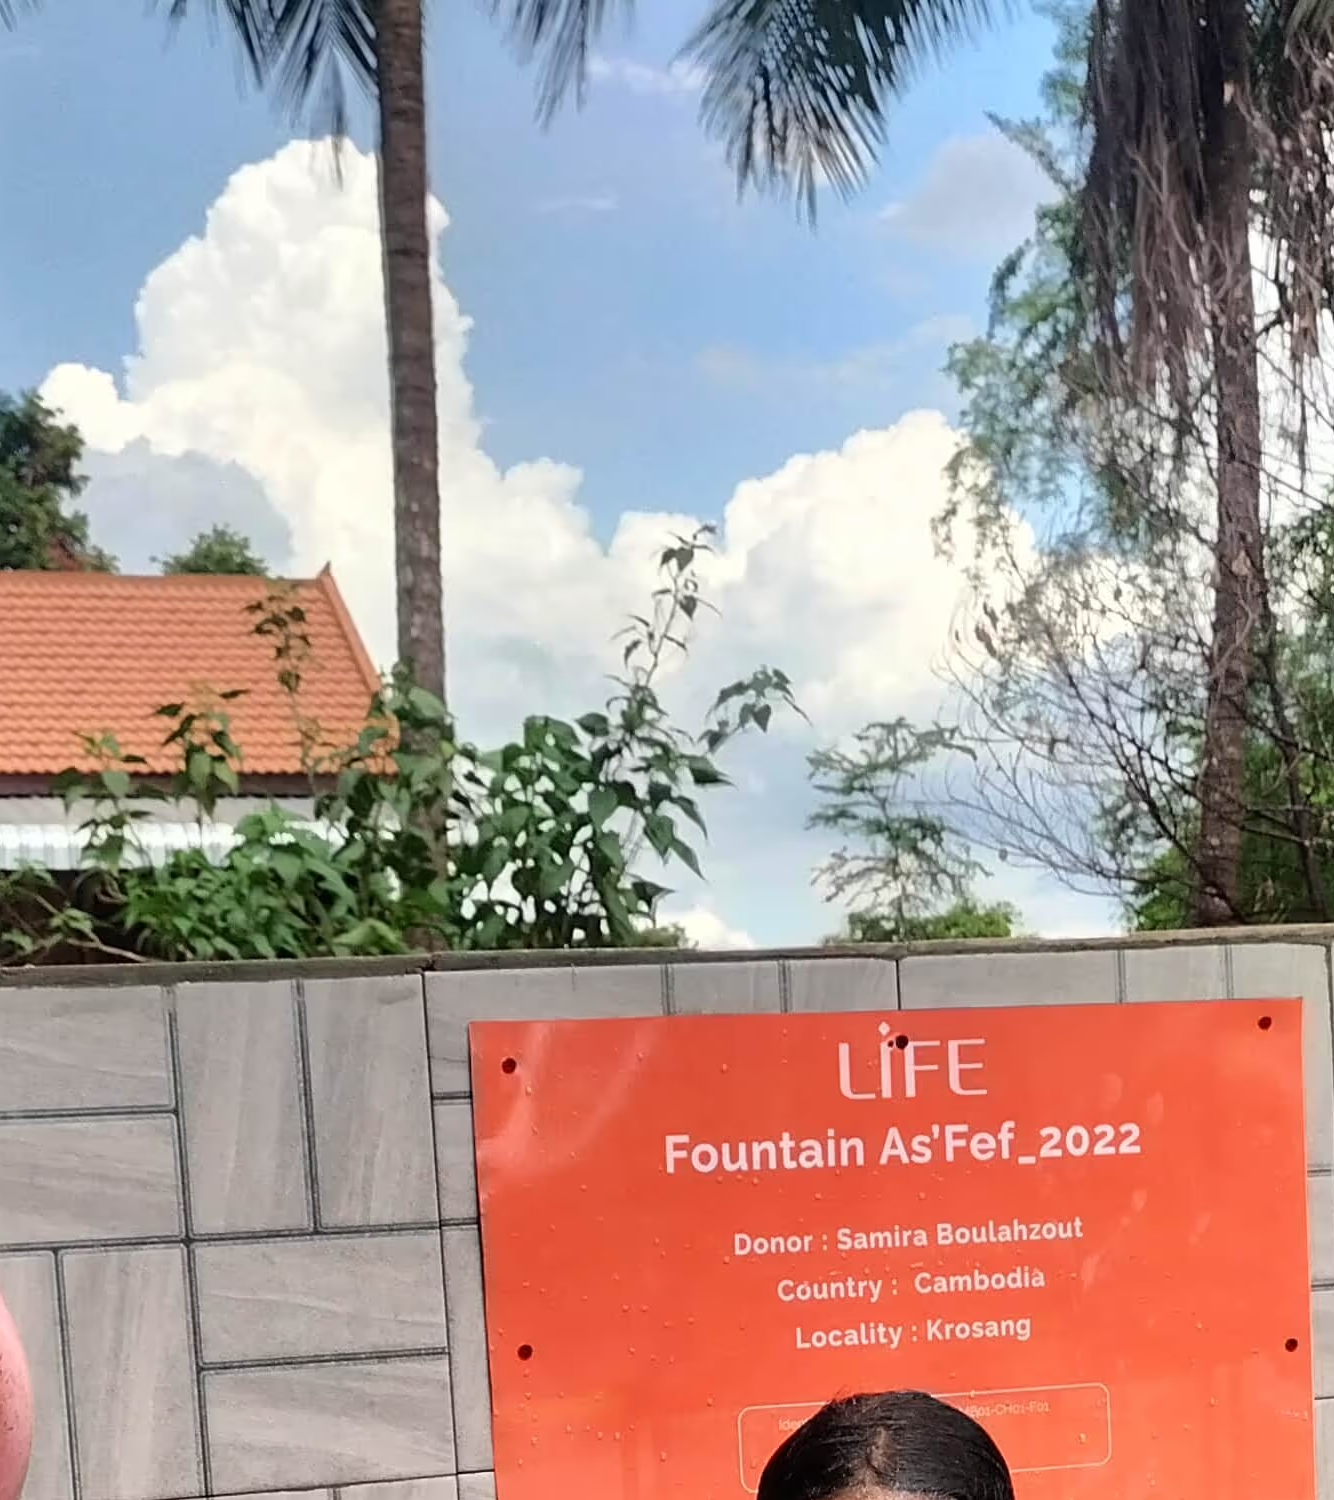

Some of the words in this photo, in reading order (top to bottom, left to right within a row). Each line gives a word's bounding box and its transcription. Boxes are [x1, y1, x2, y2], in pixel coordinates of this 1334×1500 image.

[665, 1128, 865, 1174] Fountain
[733, 1233, 813, 1256] Donor
[836, 1225, 928, 1250] Samira
[936, 1216, 1084, 1245] Boulahzout
[777, 1277, 883, 1303] Country
[914, 1266, 1046, 1294] Cambodia
[795, 1322, 903, 1349] Locality
[926, 1318, 1032, 1342] Krosang
